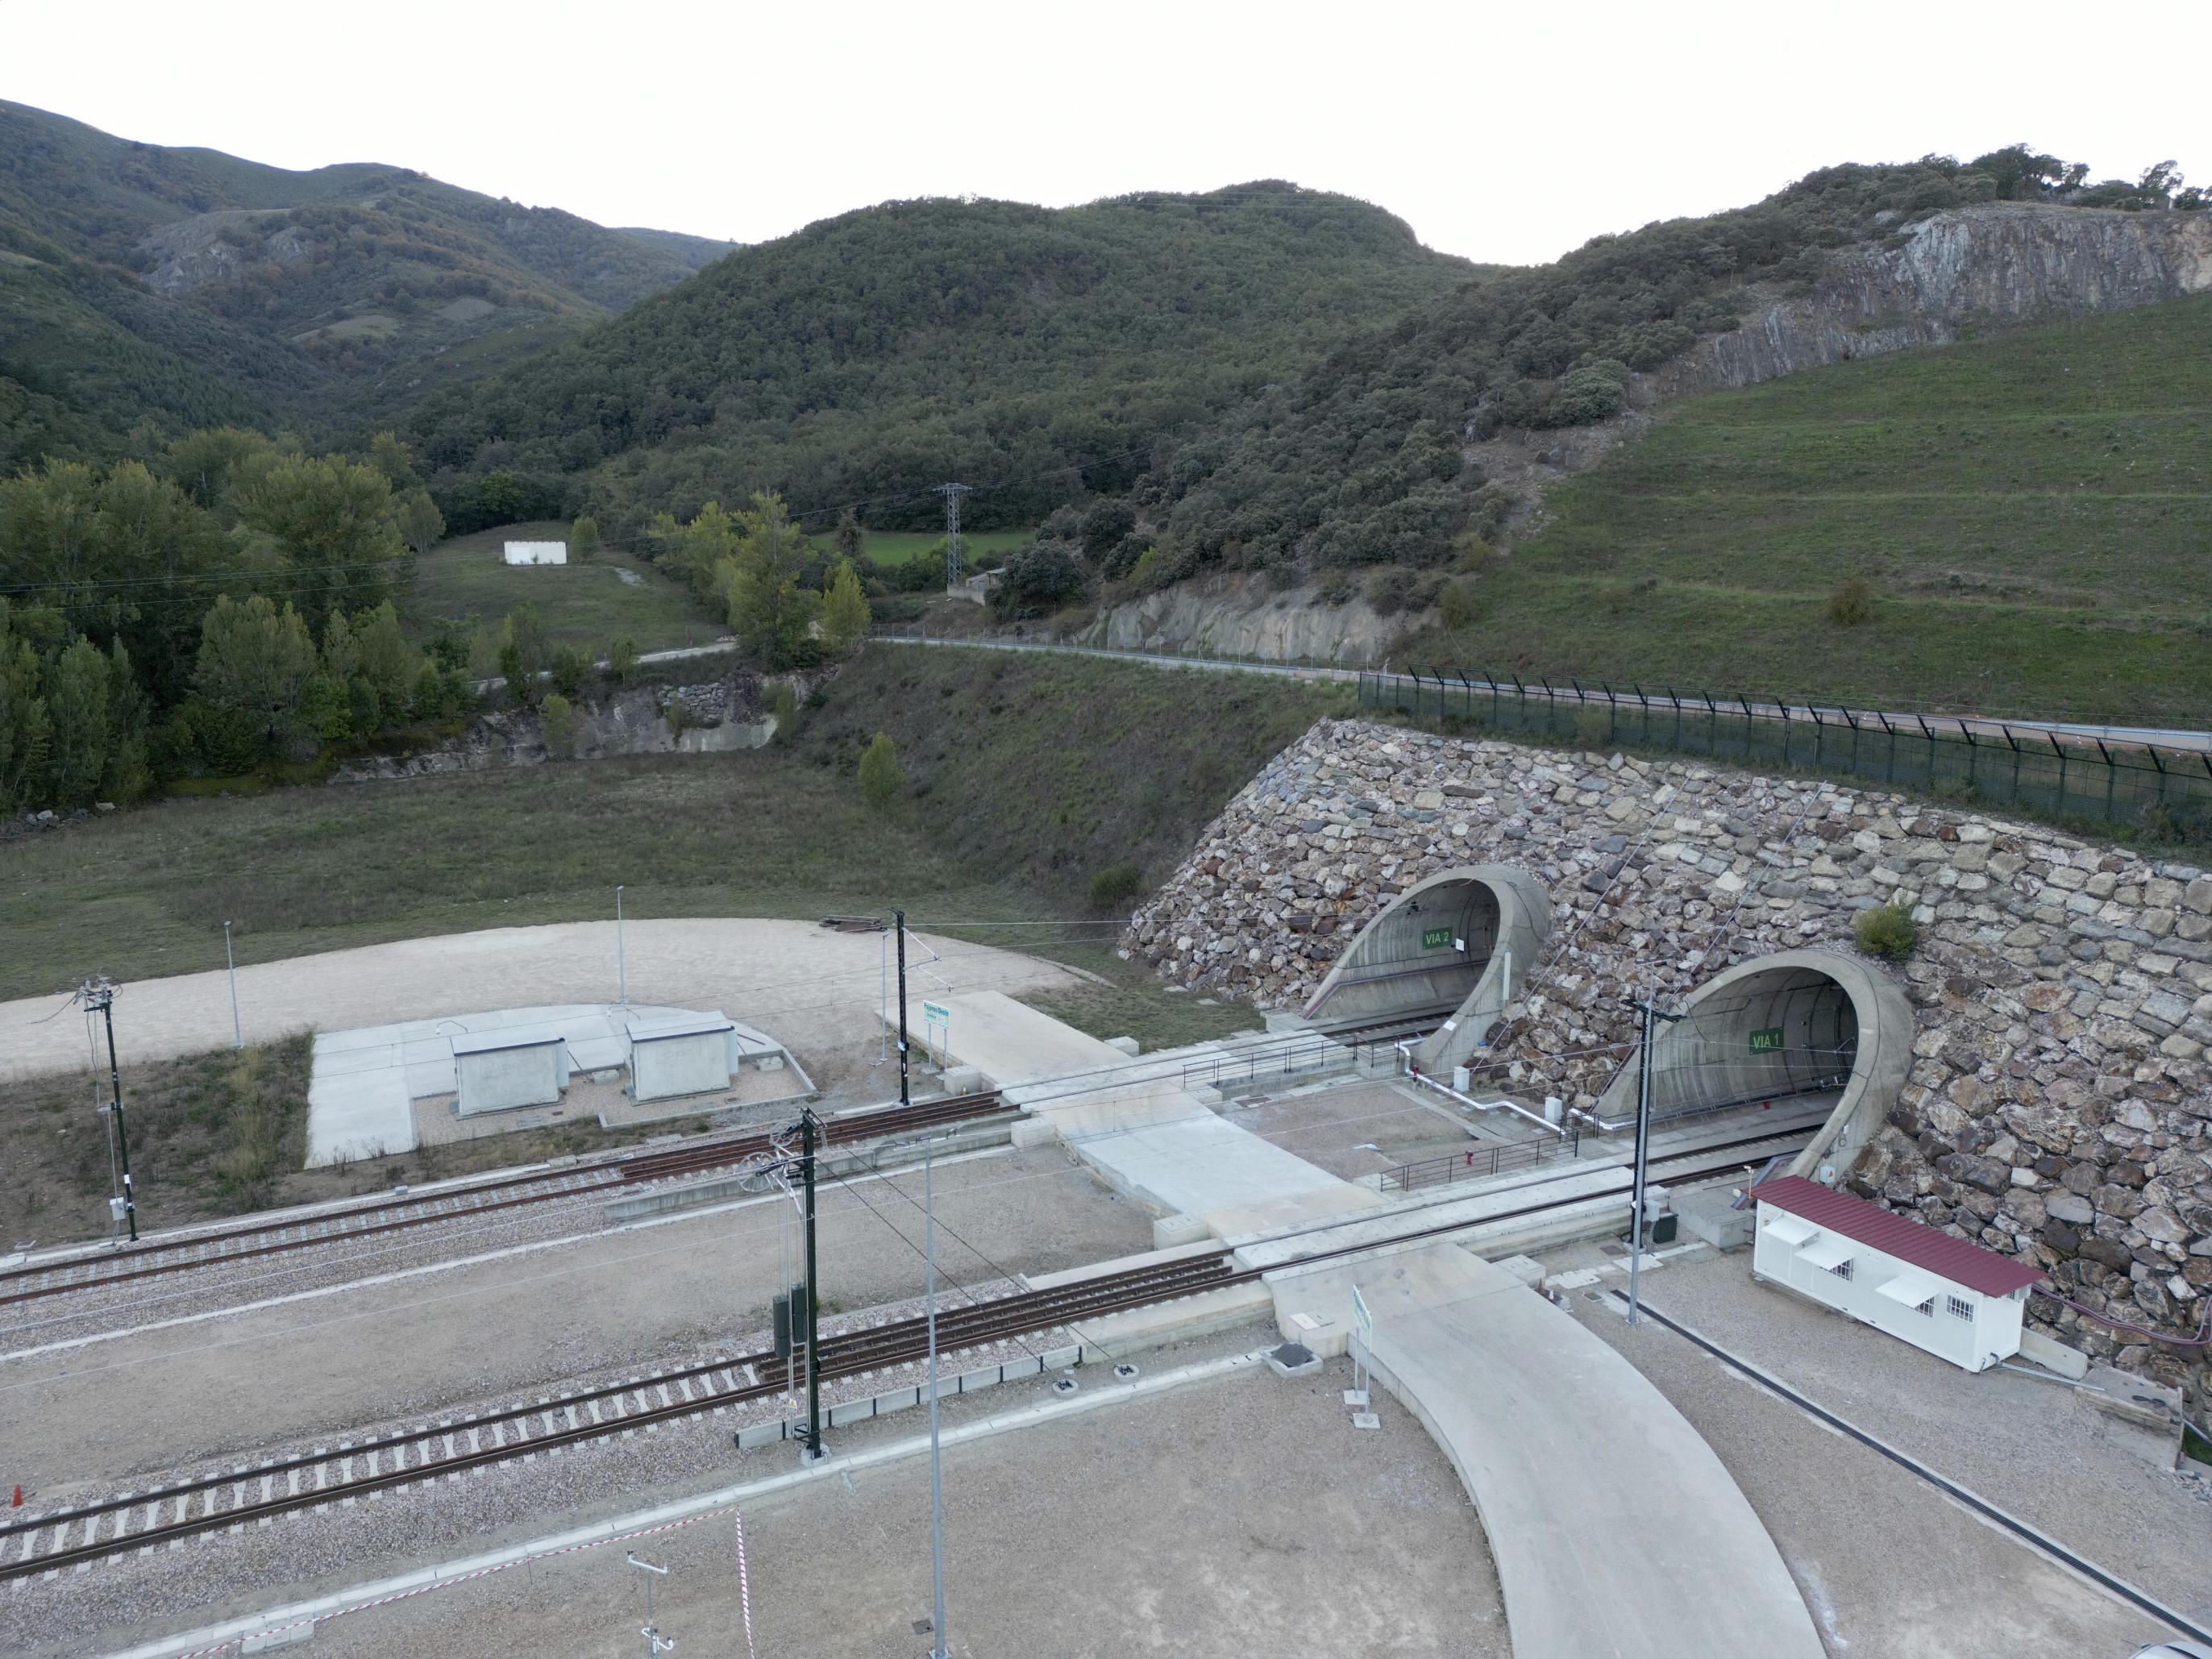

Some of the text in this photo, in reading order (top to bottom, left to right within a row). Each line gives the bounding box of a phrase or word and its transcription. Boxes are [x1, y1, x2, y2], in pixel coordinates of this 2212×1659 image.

[1426, 931, 1449, 945] VIA 2
[1753, 1033, 1779, 1050] VIA 1
